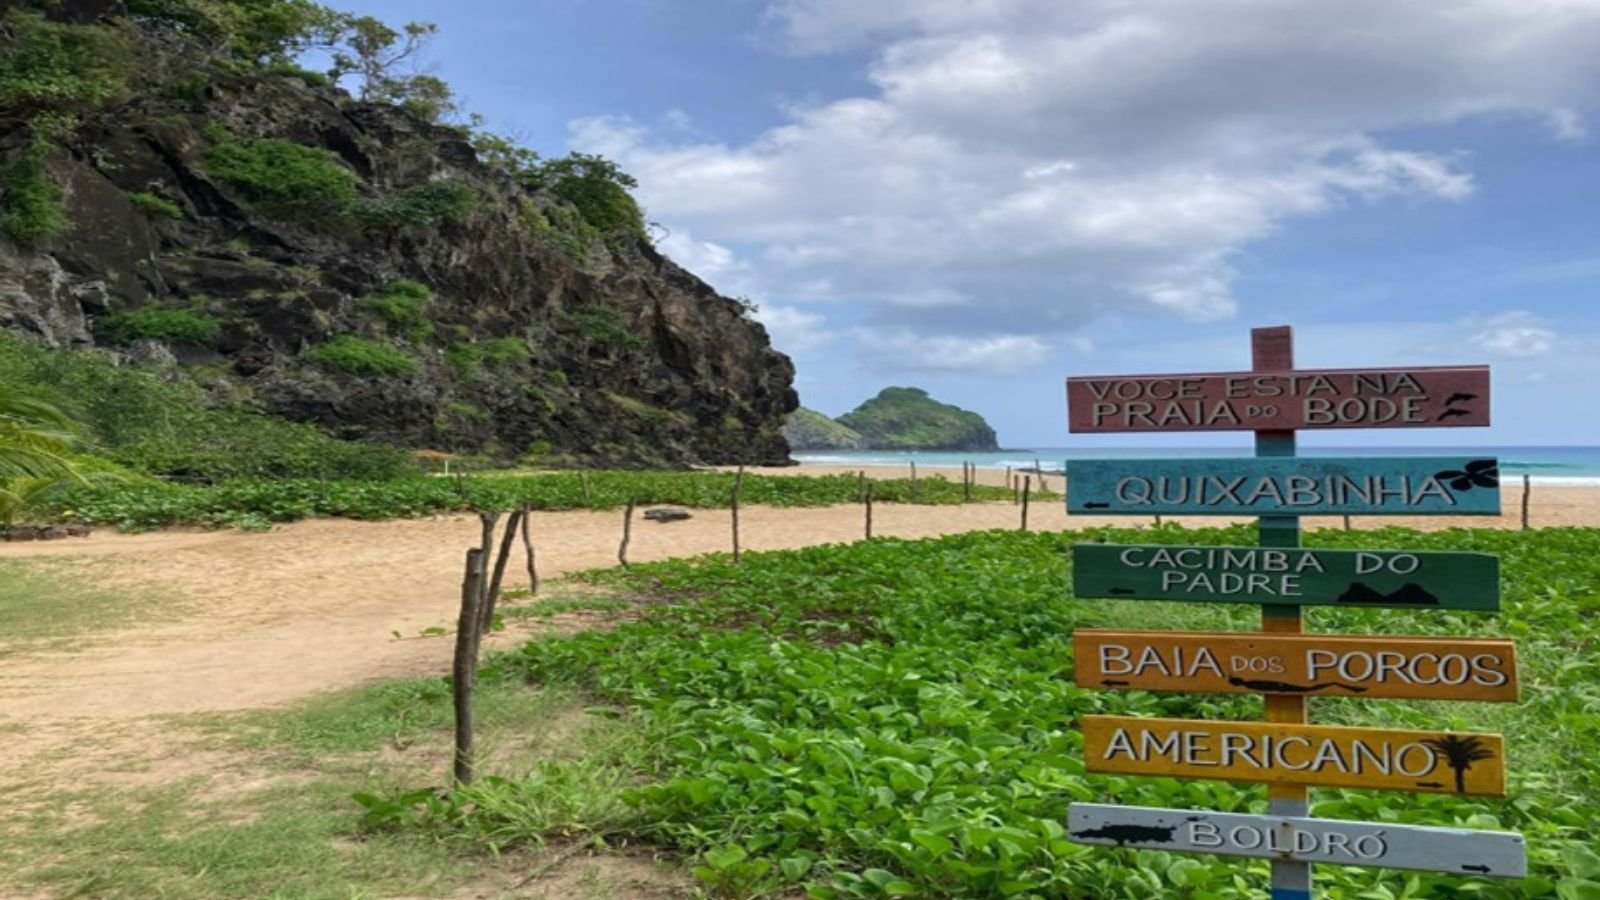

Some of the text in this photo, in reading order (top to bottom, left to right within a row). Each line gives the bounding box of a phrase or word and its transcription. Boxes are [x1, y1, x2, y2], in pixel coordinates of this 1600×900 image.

[1085, 373, 1428, 400] VOCE ESTA NA
[1091, 397, 1428, 427] PRAIA DO BODE
[1115, 475, 1457, 506] QUIXABINHA
[1120, 547, 1420, 574] CACIMBA DO
[1162, 572, 1303, 597] PADRE
[1100, 644, 1508, 687] BAIA DOS PORCOS
[1104, 728, 1439, 777] AMERICANO
[1189, 819, 1388, 859] BOLDRÓ
